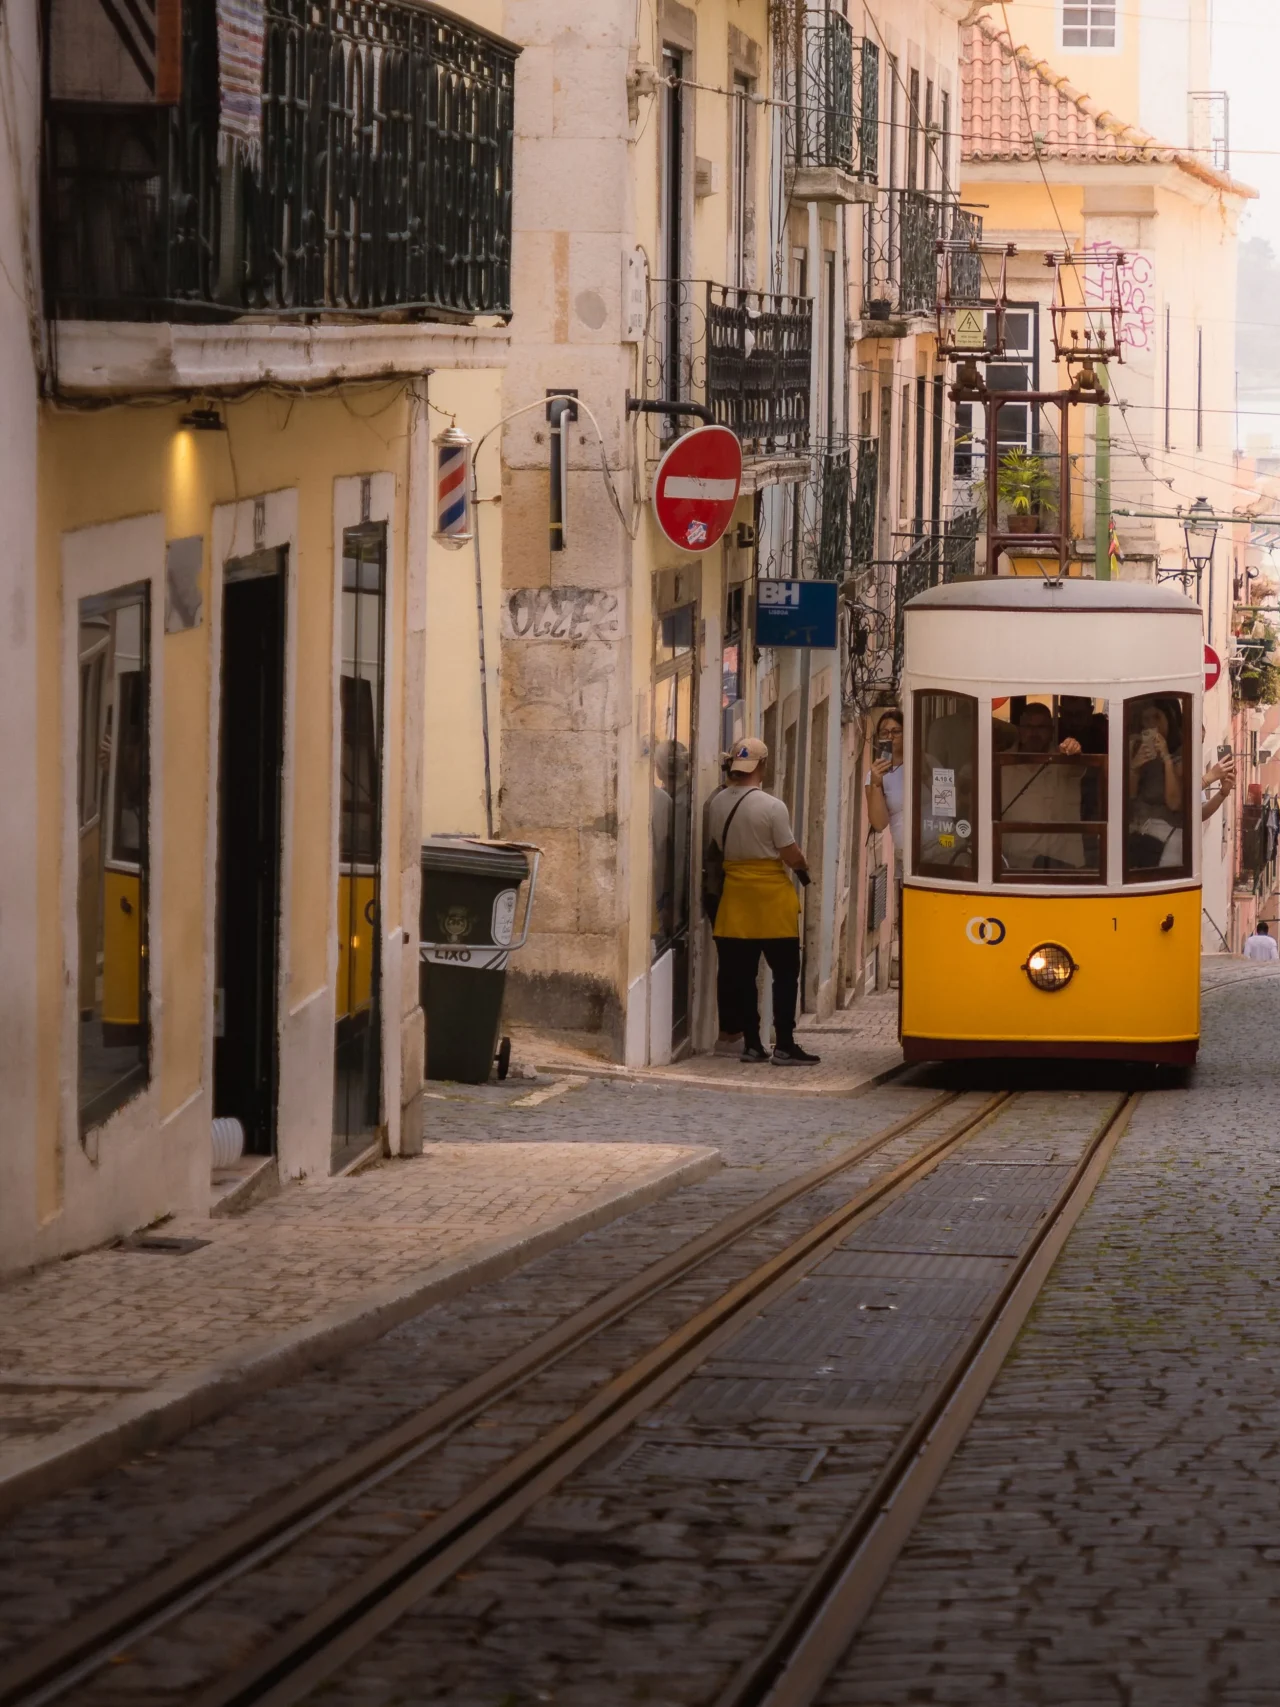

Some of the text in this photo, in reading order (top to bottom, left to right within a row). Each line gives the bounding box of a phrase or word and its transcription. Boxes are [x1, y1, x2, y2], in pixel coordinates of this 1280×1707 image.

[758, 582, 800, 605] BH
[1111, 917, 1117, 932] 1
[434, 949, 472, 962] LIXO
